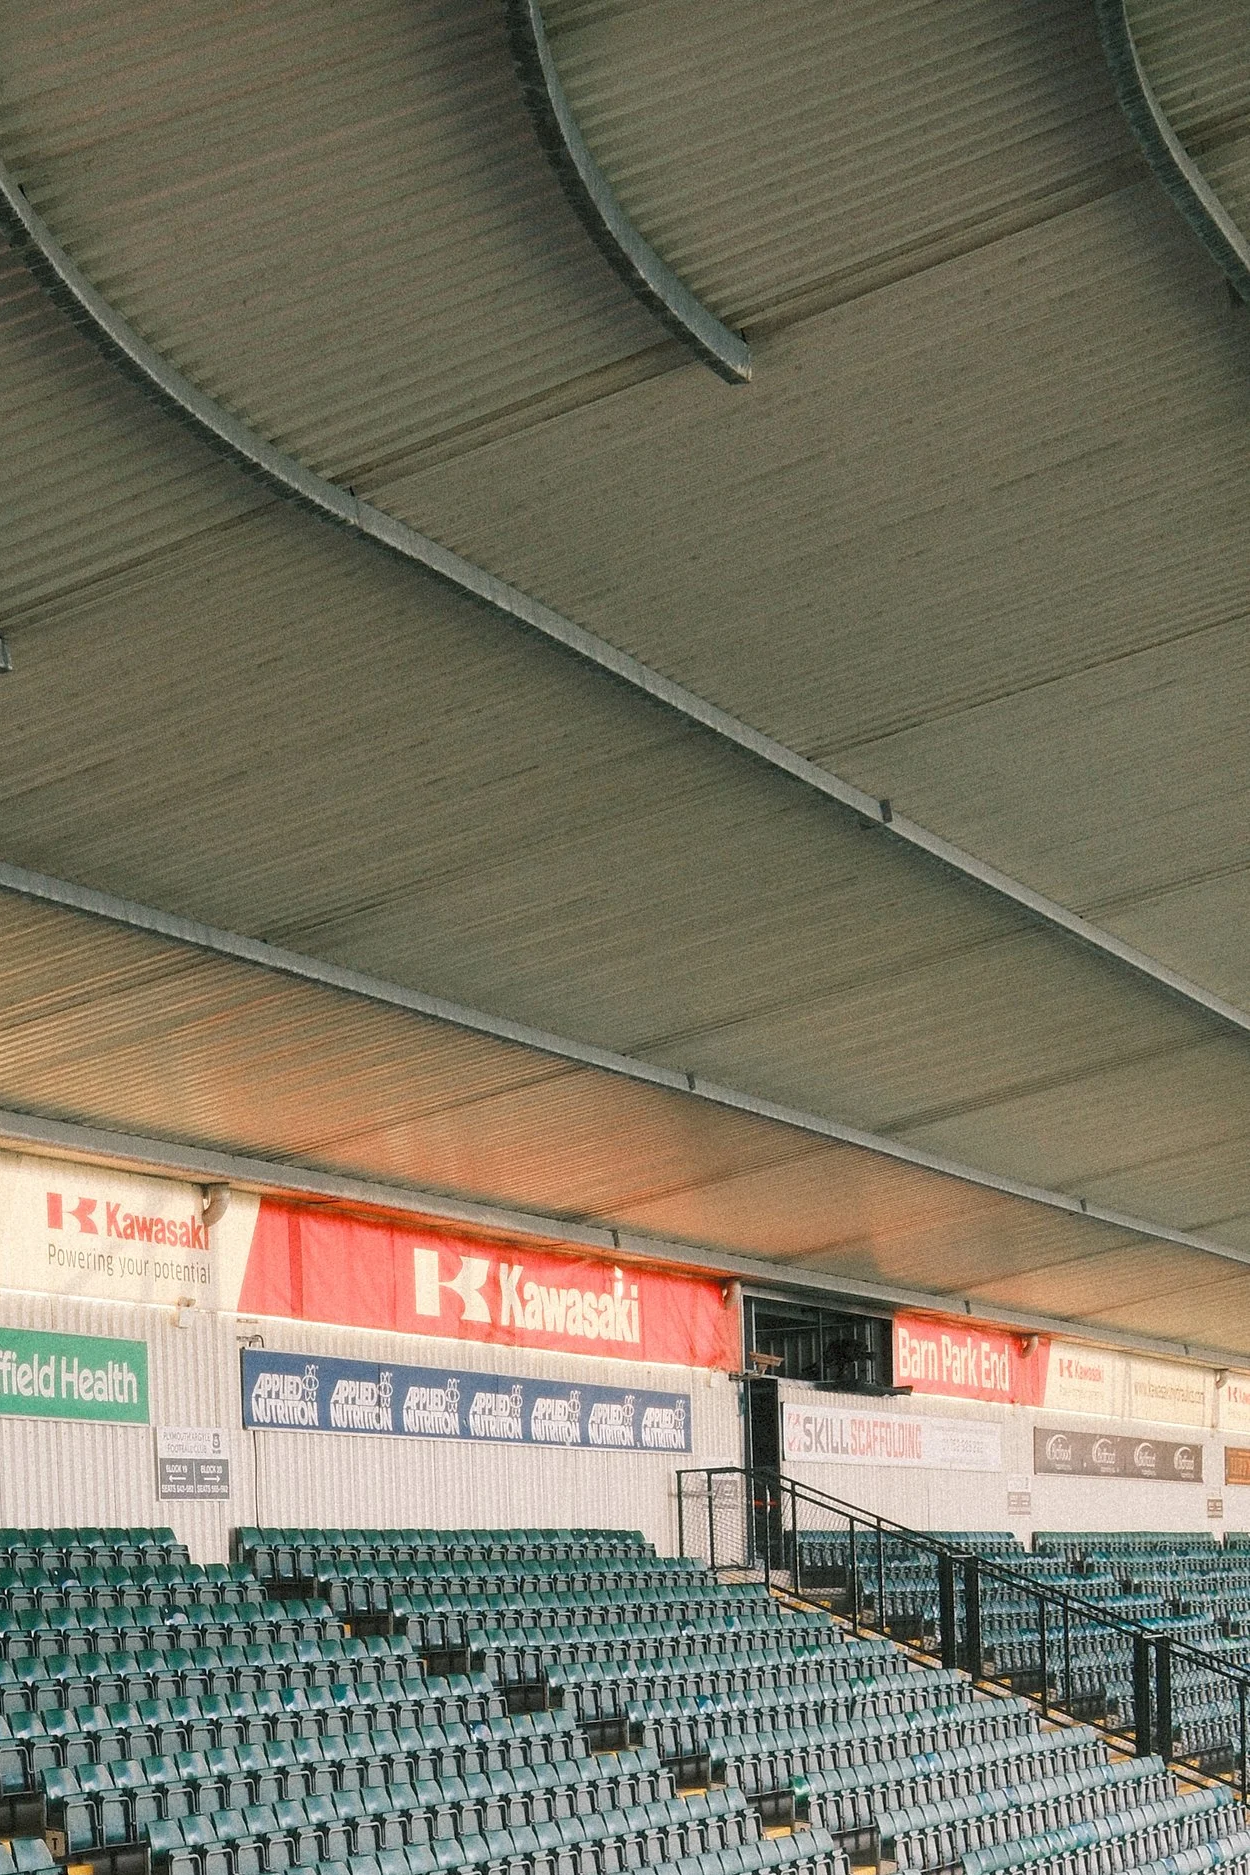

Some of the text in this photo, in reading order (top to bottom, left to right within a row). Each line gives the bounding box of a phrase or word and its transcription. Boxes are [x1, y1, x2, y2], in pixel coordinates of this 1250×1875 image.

[106, 1201, 210, 1250] Kawasaki
[48, 1243, 211, 1285] Powering your potential
[499, 1262, 640, 1344] Kawasaki
[898, 1327, 1009, 1391] Barn Park End
[60, 1357, 138, 1404] Health
[251, 1373, 303, 1400] APPLIED
[330, 1379, 378, 1406] APPLIED
[251, 1397, 319, 1426] NUTRITION
[403, 1386, 446, 1412] APPLIED
[469, 1392, 510, 1417] APPLIED
[531, 1398, 569, 1421] APPLIED
[330, 1403, 393, 1431] NUTRITION
[402, 1408, 460, 1435] NUTRITION
[469, 1414, 523, 1439] NUTRITION
[588, 1403, 623, 1426] APPLIED
[642, 1407, 676, 1429] APPLIED
[531, 1418, 581, 1443] NUTRITION
[588, 1423, 635, 1447] NUTRITION
[642, 1427, 685, 1449] NUTRITION
[53, 1837, 59, 1851] T
